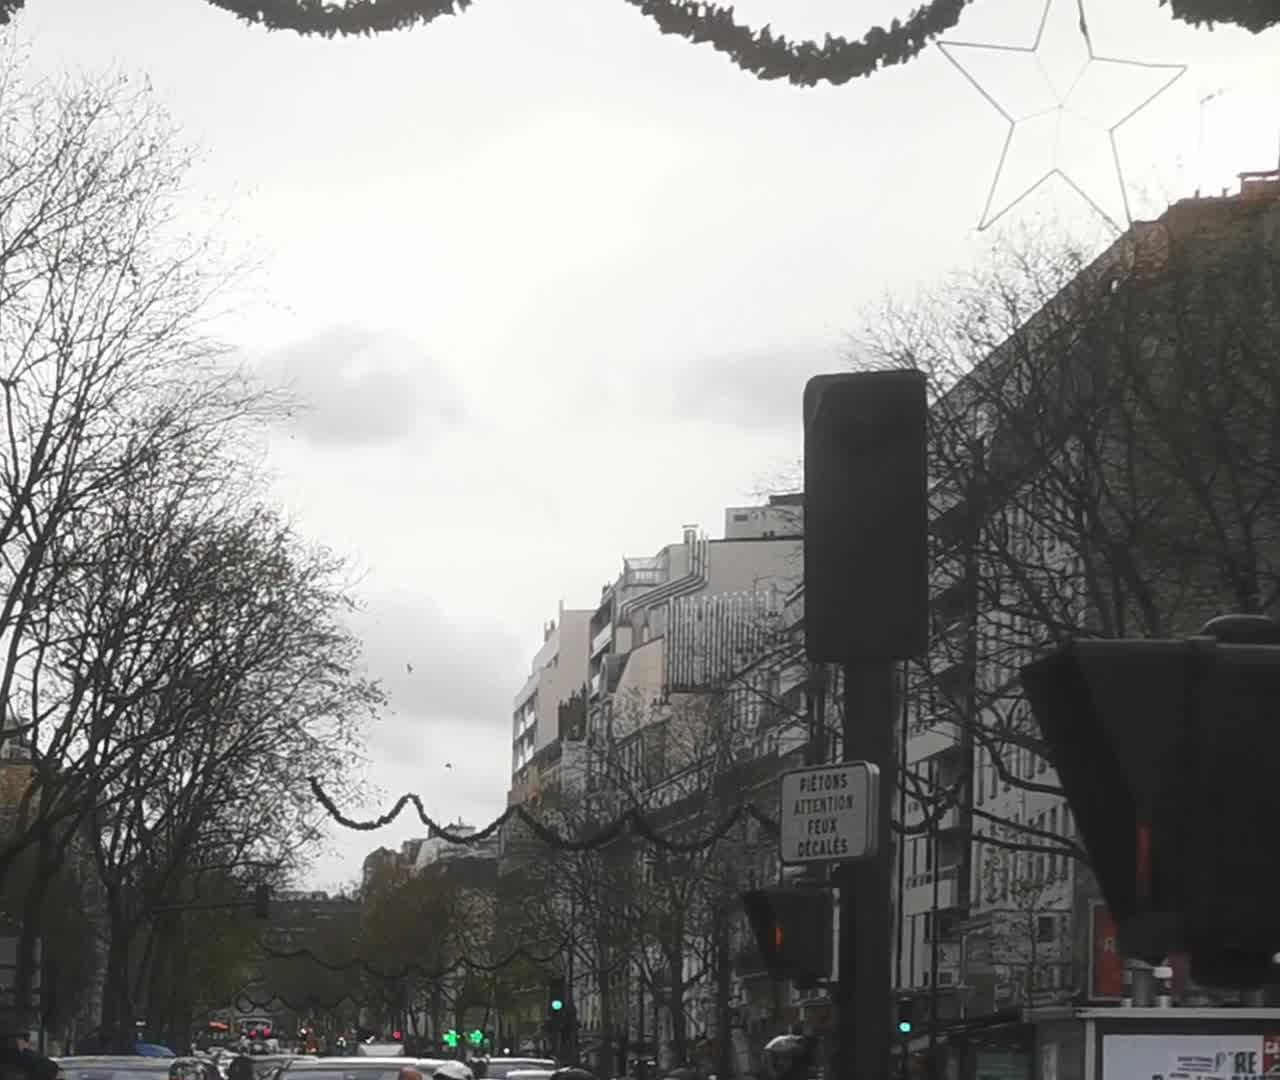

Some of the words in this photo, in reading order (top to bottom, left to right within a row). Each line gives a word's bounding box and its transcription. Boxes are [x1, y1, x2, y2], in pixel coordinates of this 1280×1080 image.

[800, 773, 849, 792] PIÉTONS
[793, 793, 854, 817] ATTENTION
[807, 819, 838, 834] FEUX
[798, 837, 849, 857] DÉCALÉS
